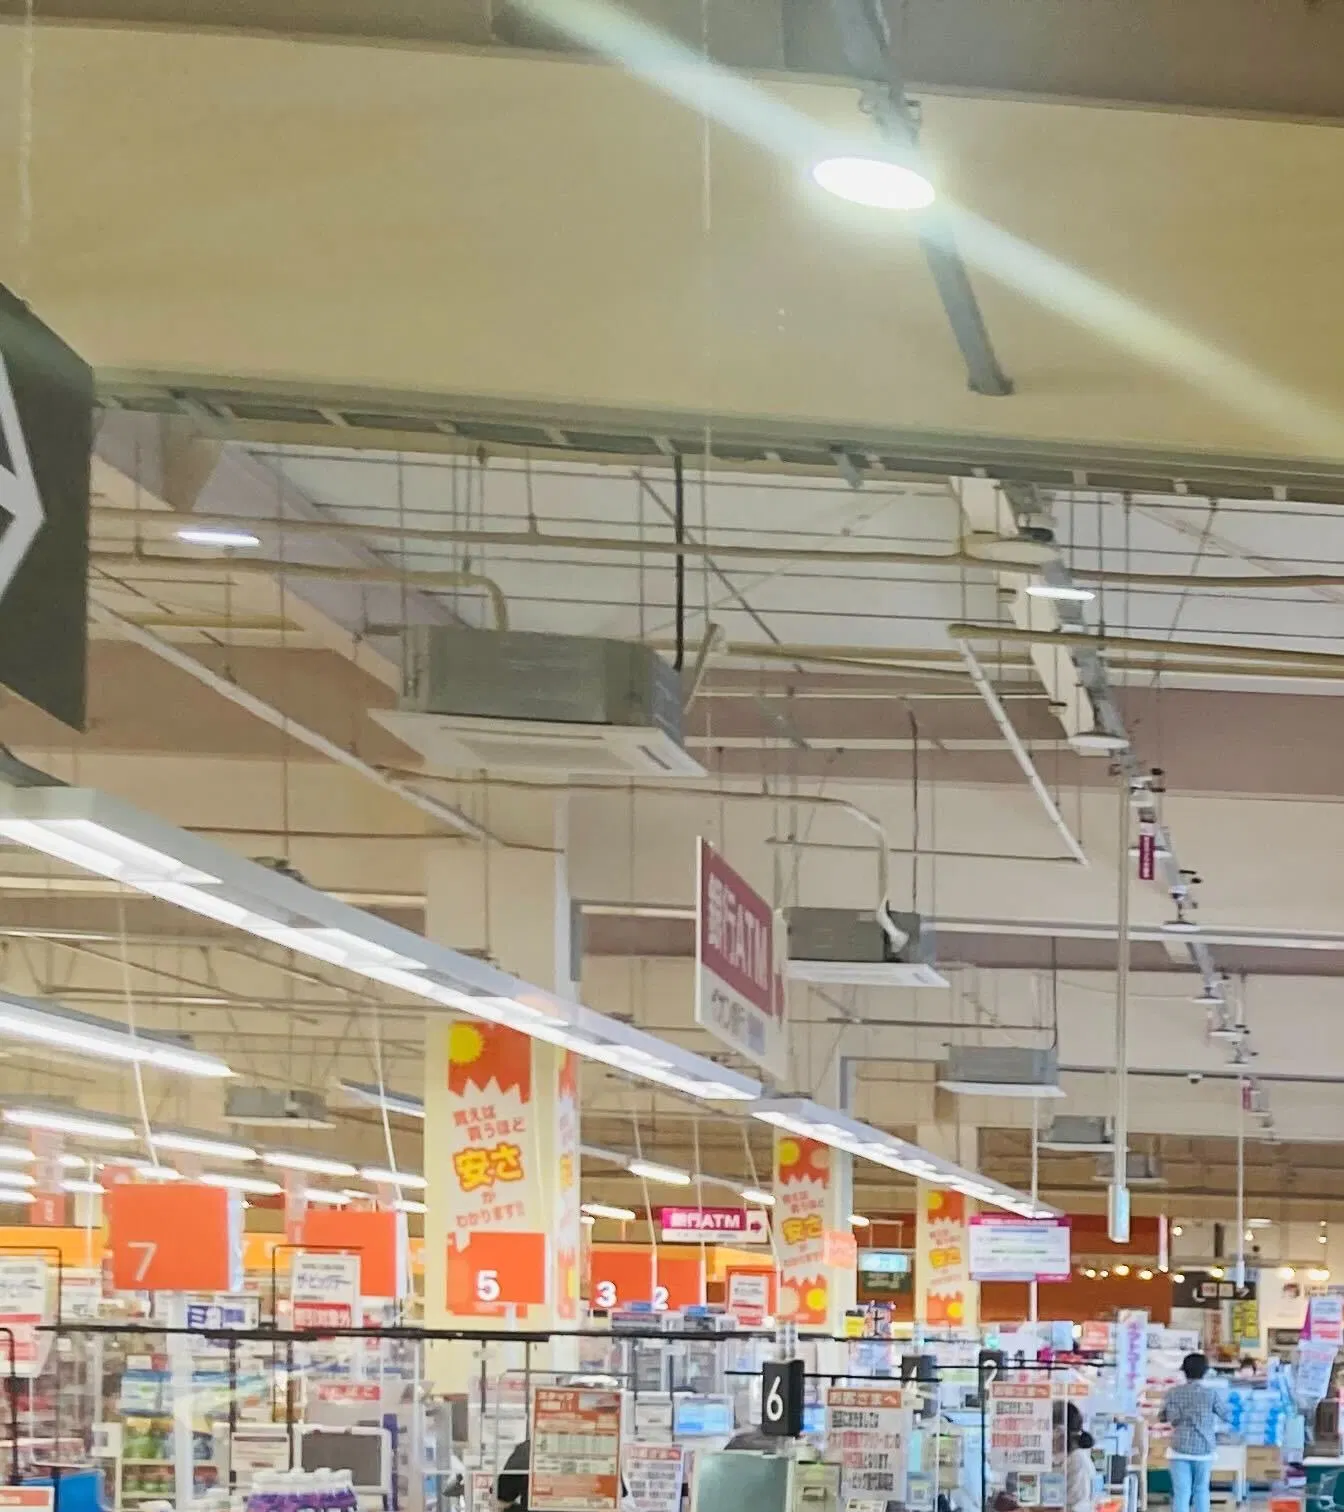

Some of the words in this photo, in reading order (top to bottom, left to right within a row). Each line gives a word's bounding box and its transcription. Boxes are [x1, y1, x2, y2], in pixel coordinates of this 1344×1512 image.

[453, 1141, 524, 1192] 安さ
[127, 1241, 157, 1282] 7
[477, 1270, 501, 1301] 5
[595, 1281, 617, 1307] 3
[655, 1285, 669, 1310] 2
[766, 1381, 784, 1421] 6
